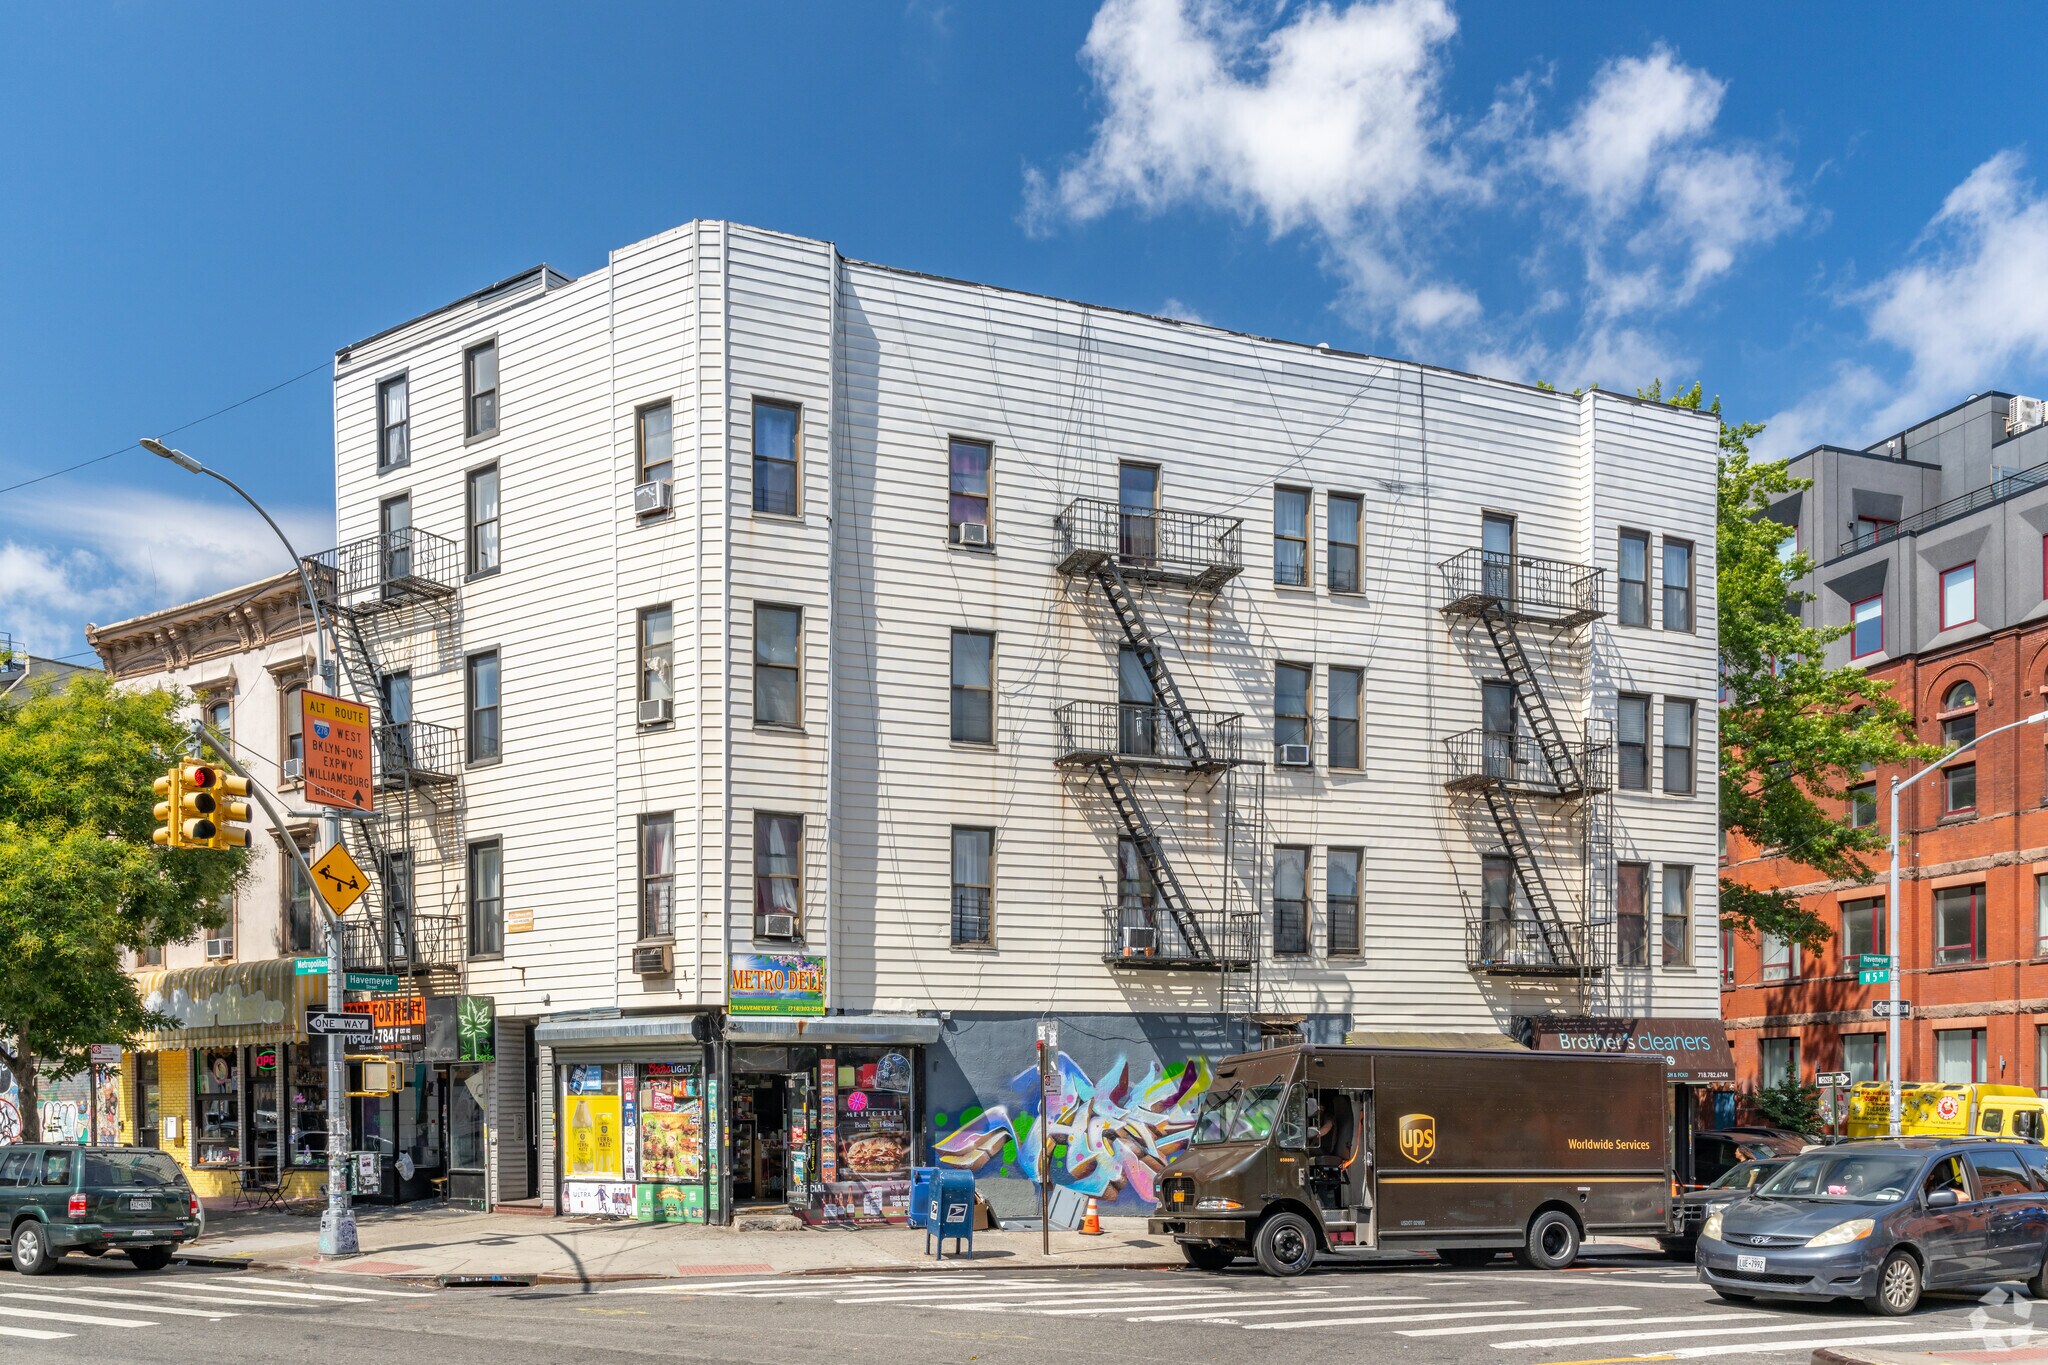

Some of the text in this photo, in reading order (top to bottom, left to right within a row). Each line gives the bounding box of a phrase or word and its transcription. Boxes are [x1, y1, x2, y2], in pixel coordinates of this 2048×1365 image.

[310, 702, 364, 723] ALT ROUTE
[316, 726, 328, 736] 278
[337, 728, 361, 743] WEST
[324, 756, 354, 772] EXPWY
[308, 767, 369, 788] WILLIAMSBURG
[315, 786, 346, 800] BRIDGE
[298, 960, 328, 970] Metropolitan
[1863, 956, 1888, 964] Havemeyer
[350, 975, 392, 986] Havemeyer
[732, 969, 822, 992] METRO DELI
[1865, 973, 1870, 982] N
[1873, 972, 1877, 982] 5
[373, 1004, 391, 1023] FOR
[394, 1002, 422, 1022] RENT
[316, 1019, 364, 1028] ONE WAY
[1559, 1032, 1710, 1051] Brother's cleaners
[256, 1055, 276, 1066] OPE
[648, 1063, 692, 1074] Coors LIGHT
[1402, 1129, 1433, 1156] ups
[1568, 1138, 1650, 1150] Worldwide Services
[794, 1184, 826, 1192] OFFCIAL
